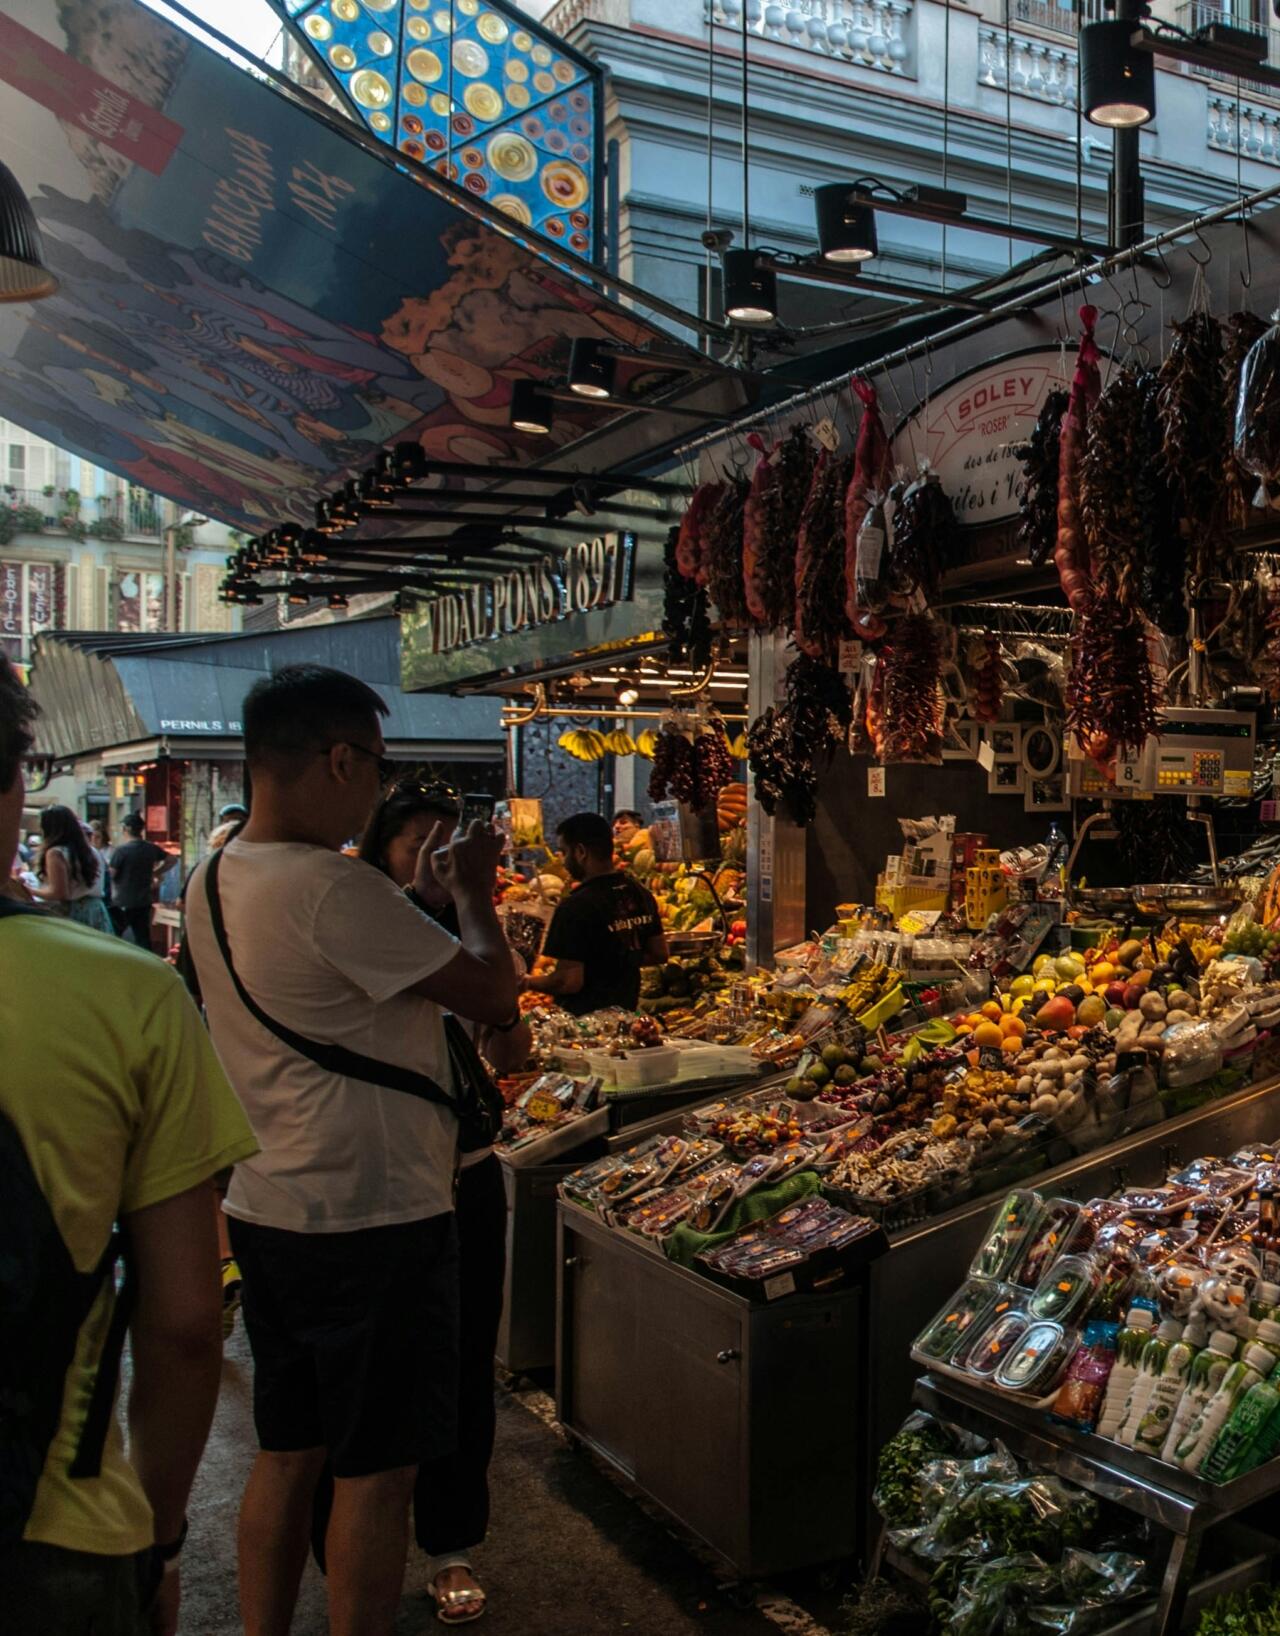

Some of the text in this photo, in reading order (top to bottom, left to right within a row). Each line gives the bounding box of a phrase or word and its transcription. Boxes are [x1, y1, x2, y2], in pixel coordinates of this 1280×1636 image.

[202, 127, 276, 261] BARCELONA
[958, 377, 1034, 420] SOLEY
[4, 568, 17, 631] EROTIC
[430, 532, 622, 653] VIDAL PONS 1897
[160, 719, 222, 731] PERNILS
